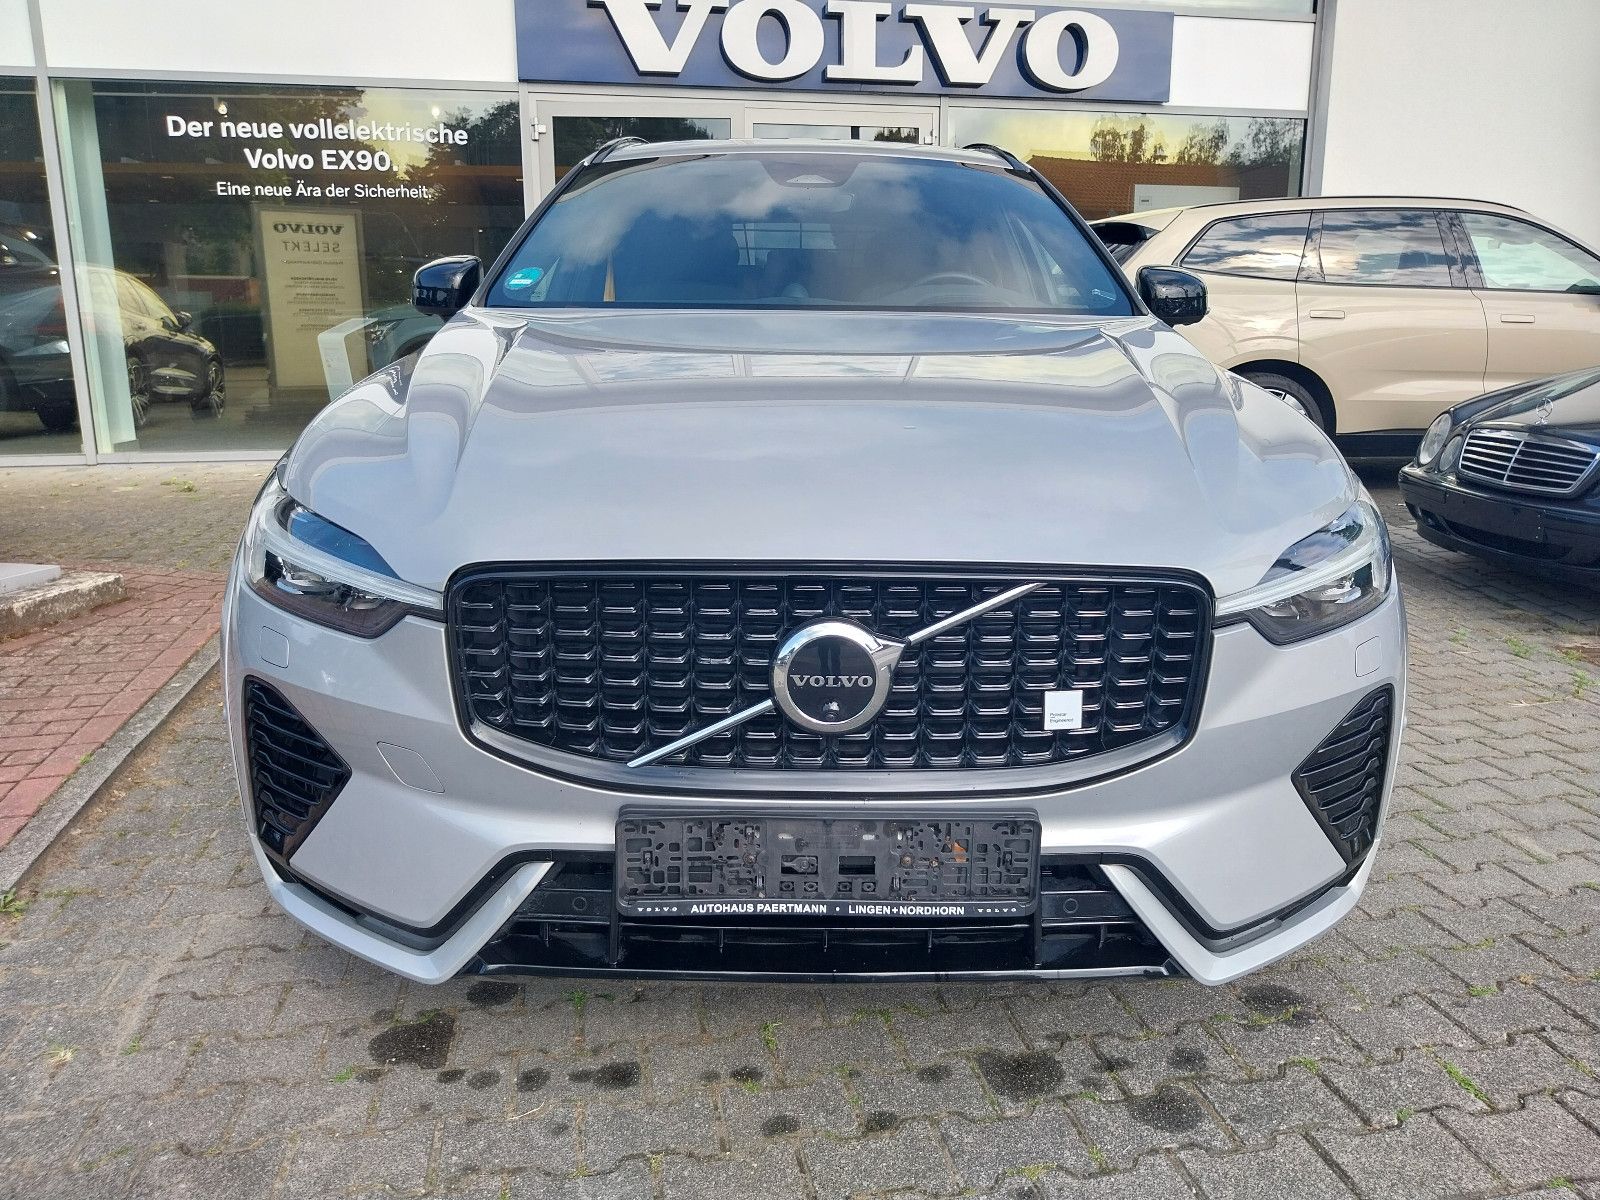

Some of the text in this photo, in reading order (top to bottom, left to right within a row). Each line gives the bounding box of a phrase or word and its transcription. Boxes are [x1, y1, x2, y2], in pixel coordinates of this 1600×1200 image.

[588, 0, 1119, 91] VOLVO
[166, 115, 469, 145] Der neue vollelektrische
[243, 148, 399, 172] Volvo EX90.
[216, 180, 432, 199] Eine neue Ära der Sicherheit.
[789, 674, 874, 688] VOLVO
[690, 903, 755, 914] AUTOHAUS
[756, 903, 827, 914] PAERTMANN
[848, 904, 965, 915] LINGEN+NORDHORN
